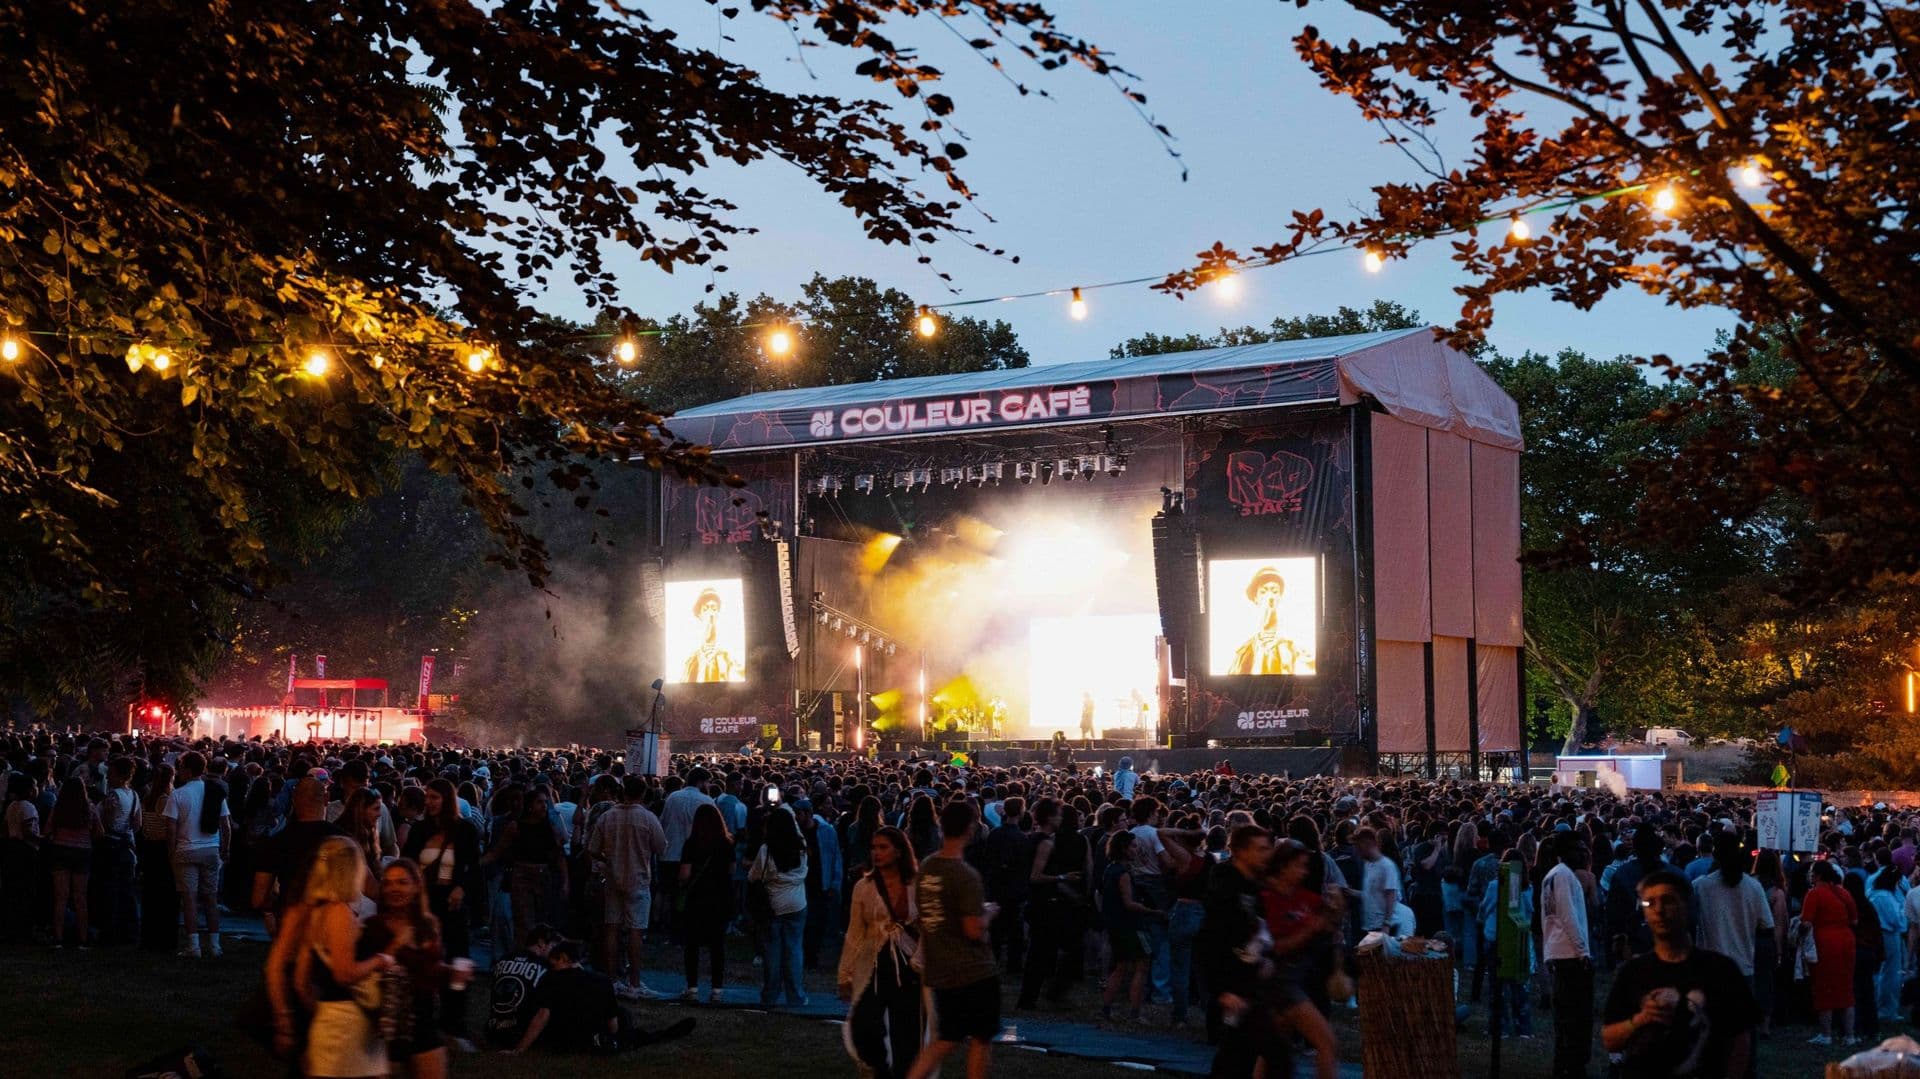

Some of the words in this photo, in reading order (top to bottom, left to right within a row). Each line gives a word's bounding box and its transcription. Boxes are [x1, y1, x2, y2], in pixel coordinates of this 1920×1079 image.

[840, 398, 993, 434] COULEUR
[1000, 386, 1091, 422] CAFÉ
[422, 661, 433, 696] BRUZZ
[1256, 708, 1310, 720] COULEUR
[715, 717, 757, 725] COULEUR
[1256, 718, 1287, 729] CAFÉ
[715, 725, 739, 733] CAFÉ
